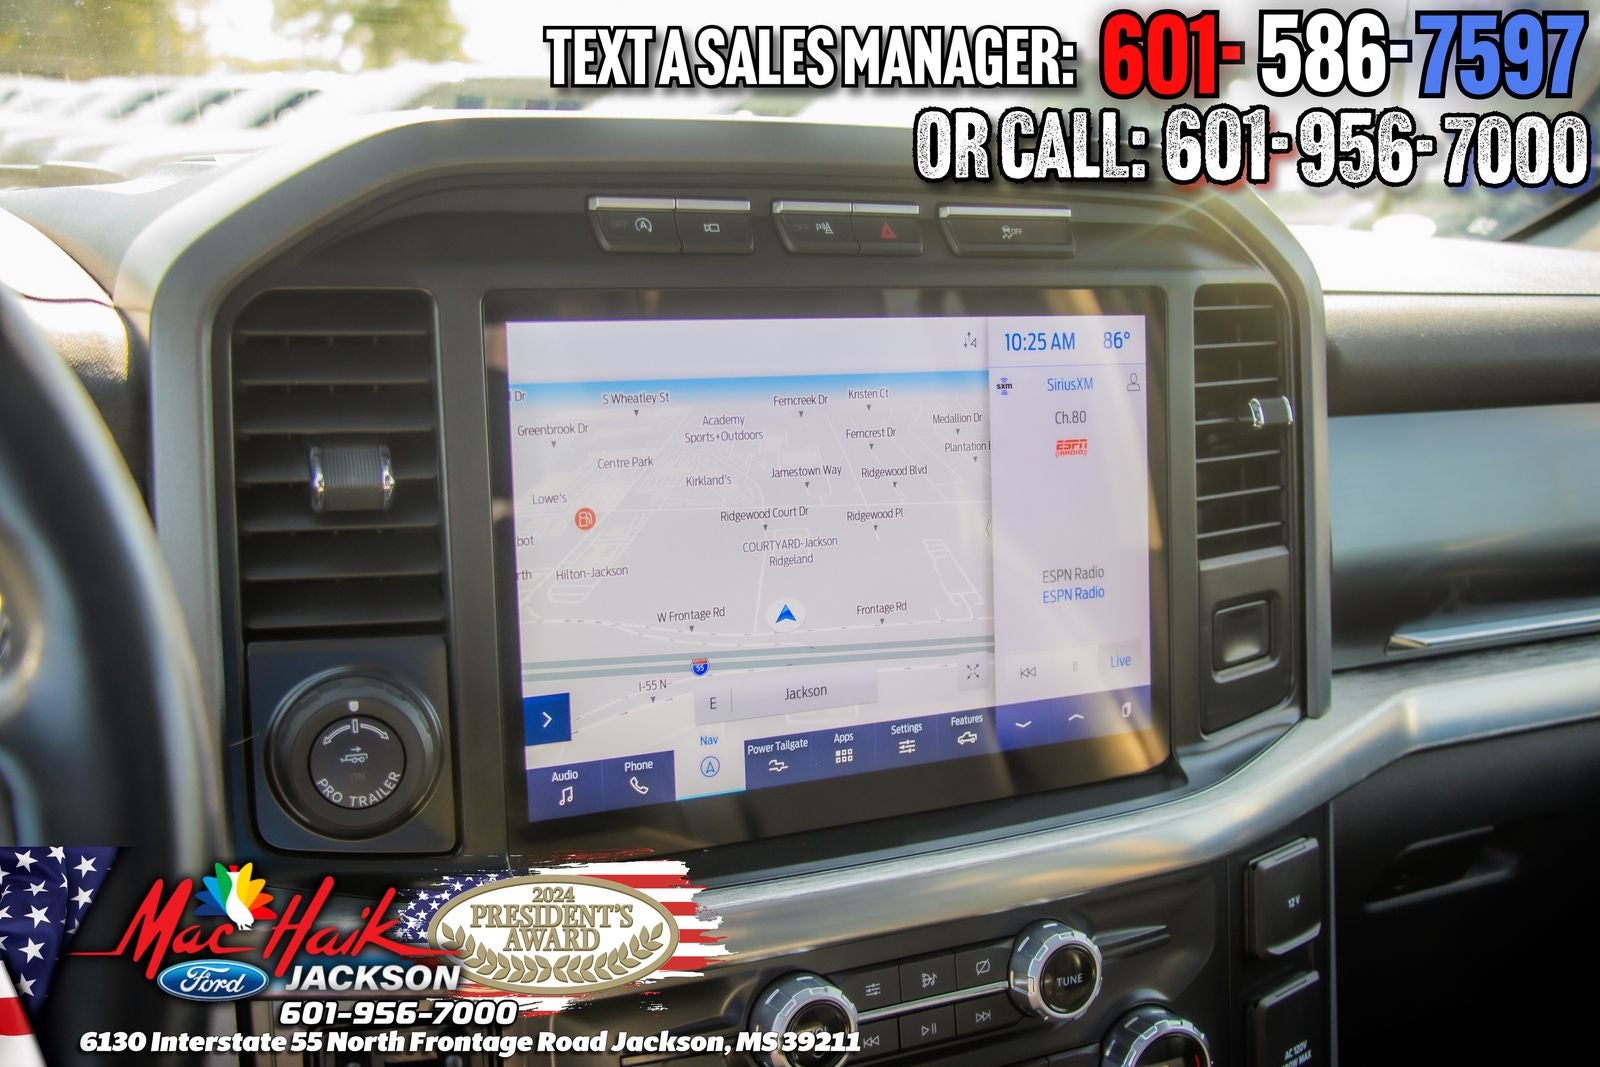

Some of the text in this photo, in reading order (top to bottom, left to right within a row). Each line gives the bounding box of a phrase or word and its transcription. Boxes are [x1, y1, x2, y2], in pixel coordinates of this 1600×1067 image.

[1005, 332, 1076, 351] 10:25 AM
[1047, 377, 1094, 391] SiriusXM
[515, 391, 526, 401] Dr
[603, 391, 670, 404] S Wheatley St
[774, 394, 828, 406] Ferncreek Dr
[848, 388, 889, 399] Kristen Ct
[703, 415, 745, 427] Academy
[933, 413, 983, 424] Medallion Dr
[1055, 411, 1087, 424] Ch.80
[518, 423, 589, 436] Greenbrook Dr
[846, 427, 897, 439] Ferncrest Dr
[945, 441, 987, 452] Plantation
[1056, 439, 1088, 450] ESPN
[598, 456, 654, 469] Centre Park
[772, 464, 842, 478] Jamestown Way
[862, 465, 928, 479] Ridgewood Blvd
[686, 475, 732, 487] Kirkland's
[532, 493, 567, 505] Lowe's
[720, 505, 809, 522] Ridgewood Court Dr
[847, 508, 904, 522] Ridgewood Pl
[742, 536, 838, 552] COURTYARD-Jackson
[769, 554, 813, 567] Ridgeland
[556, 566, 629, 581] Hilton-Jackson
[1042, 566, 1105, 583] ESPN Radio
[1043, 586, 1105, 604] ESPN Radio
[657, 607, 726, 623] W Frontage Rd
[856, 601, 907, 616] Frontage Rd
[1110, 655, 1132, 668] Live
[638, 679, 667, 692] I-55 N
[785, 685, 828, 700] Jackson
[709, 697, 717, 710] E
[951, 714, 984, 726] Features
[891, 722, 923, 735] Settings
[700, 736, 718, 746] Nav
[833, 733, 854, 743] Apps
[747, 738, 809, 755] Power Tailgate
[624, 760, 653, 772] Phone
[552, 770, 579, 782] Audio
[316, 771, 401, 807] PRO TRAILER
[1055, 973, 1083, 987] TUNE
